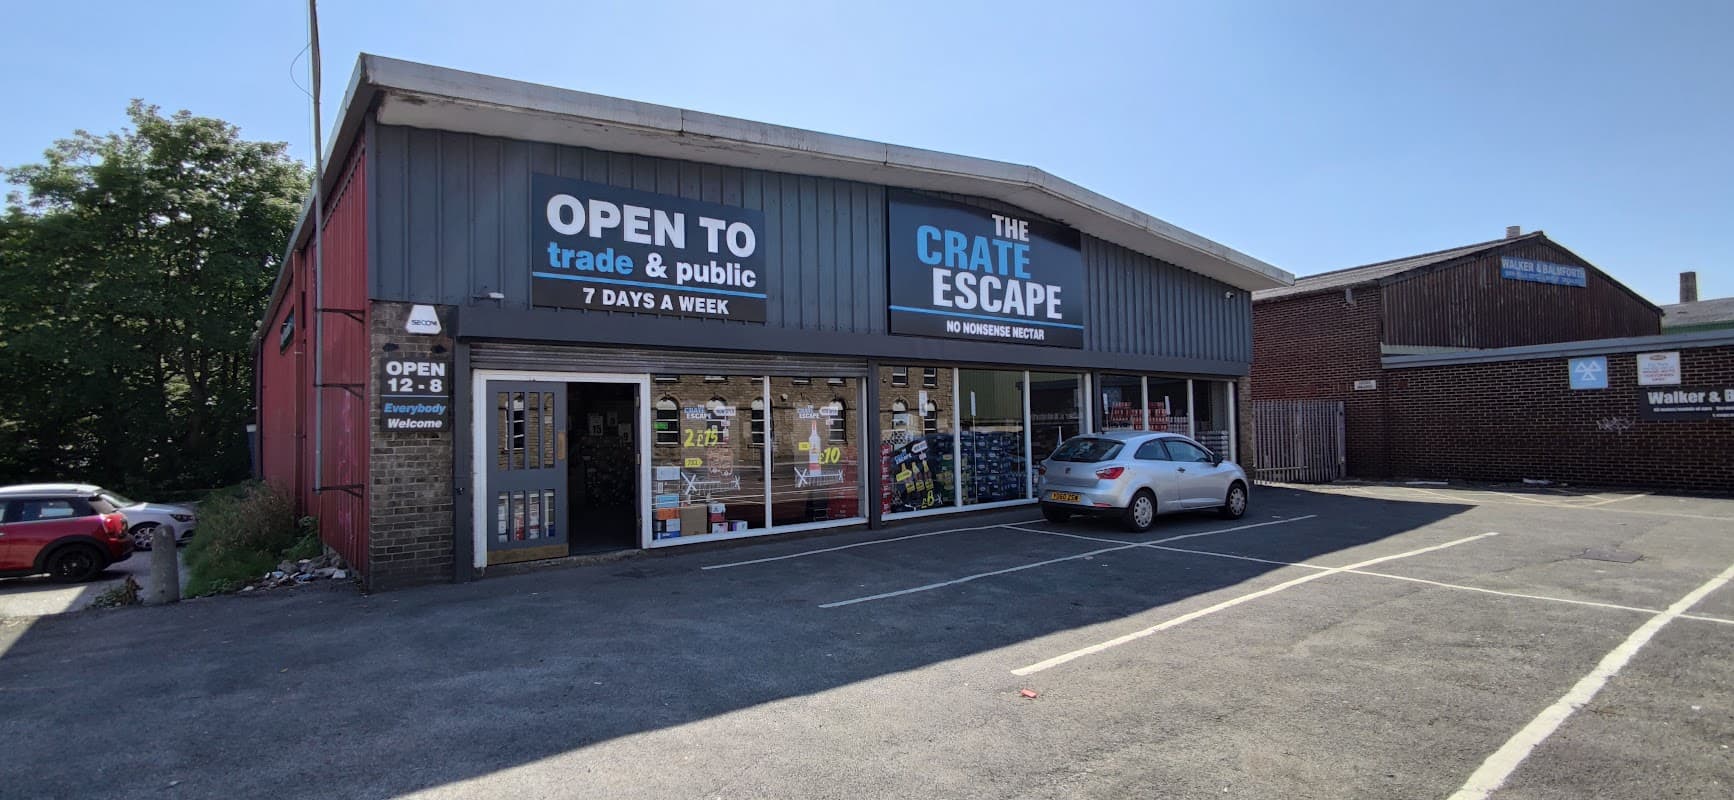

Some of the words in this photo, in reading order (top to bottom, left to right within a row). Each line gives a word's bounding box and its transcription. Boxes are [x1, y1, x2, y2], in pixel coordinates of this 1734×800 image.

[546, 193, 685, 249] OPEN
[699, 216, 756, 258] TO
[991, 213, 1030, 242] THE
[916, 224, 1031, 280] CRATE
[547, 241, 633, 275] trade
[645, 252, 668, 279] &
[676, 260, 757, 288] public
[1502, 258, 1534, 272] WALKER
[582, 287, 595, 304] 7
[602, 289, 655, 309] DAYS
[660, 294, 673, 311] A
[678, 296, 729, 315] WEEK
[932, 267, 1063, 320] ESCAPE
[946, 320, 961, 333] NO
[963, 321, 1011, 338] NONSENSE
[1012, 326, 1045, 341] NECTAR
[385, 360, 446, 377] OPEN
[387, 377, 413, 392] 12
[429, 378, 443, 393] 8
[1647, 390, 1706, 405] Walker
[1709, 391, 1722, 403] &
[383, 403, 446, 415] Everybody
[387, 418, 443, 429] Welcome
